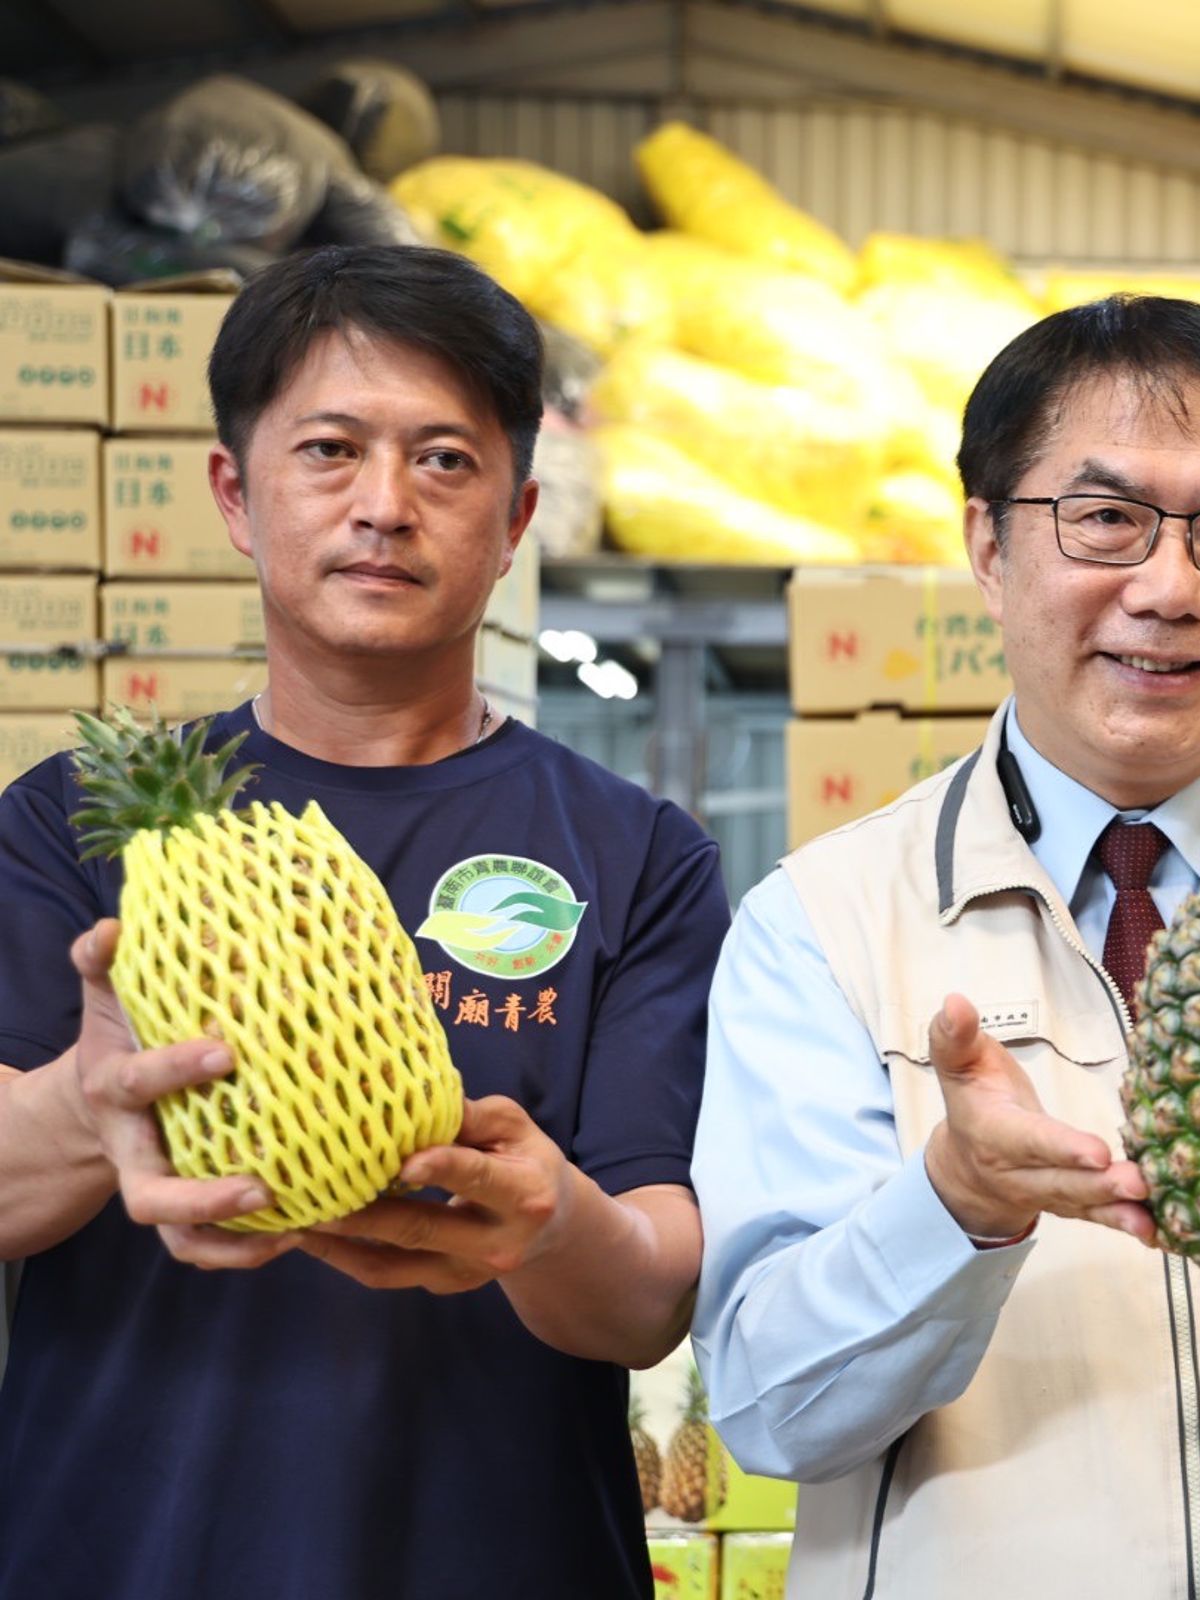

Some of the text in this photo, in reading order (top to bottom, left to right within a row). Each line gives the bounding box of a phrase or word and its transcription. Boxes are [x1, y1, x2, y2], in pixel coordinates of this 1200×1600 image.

[138, 384, 168, 409] N
[131, 530, 160, 557] N
[829, 632, 857, 660] N
[129, 674, 157, 700] N
[822, 776, 853, 805] N
